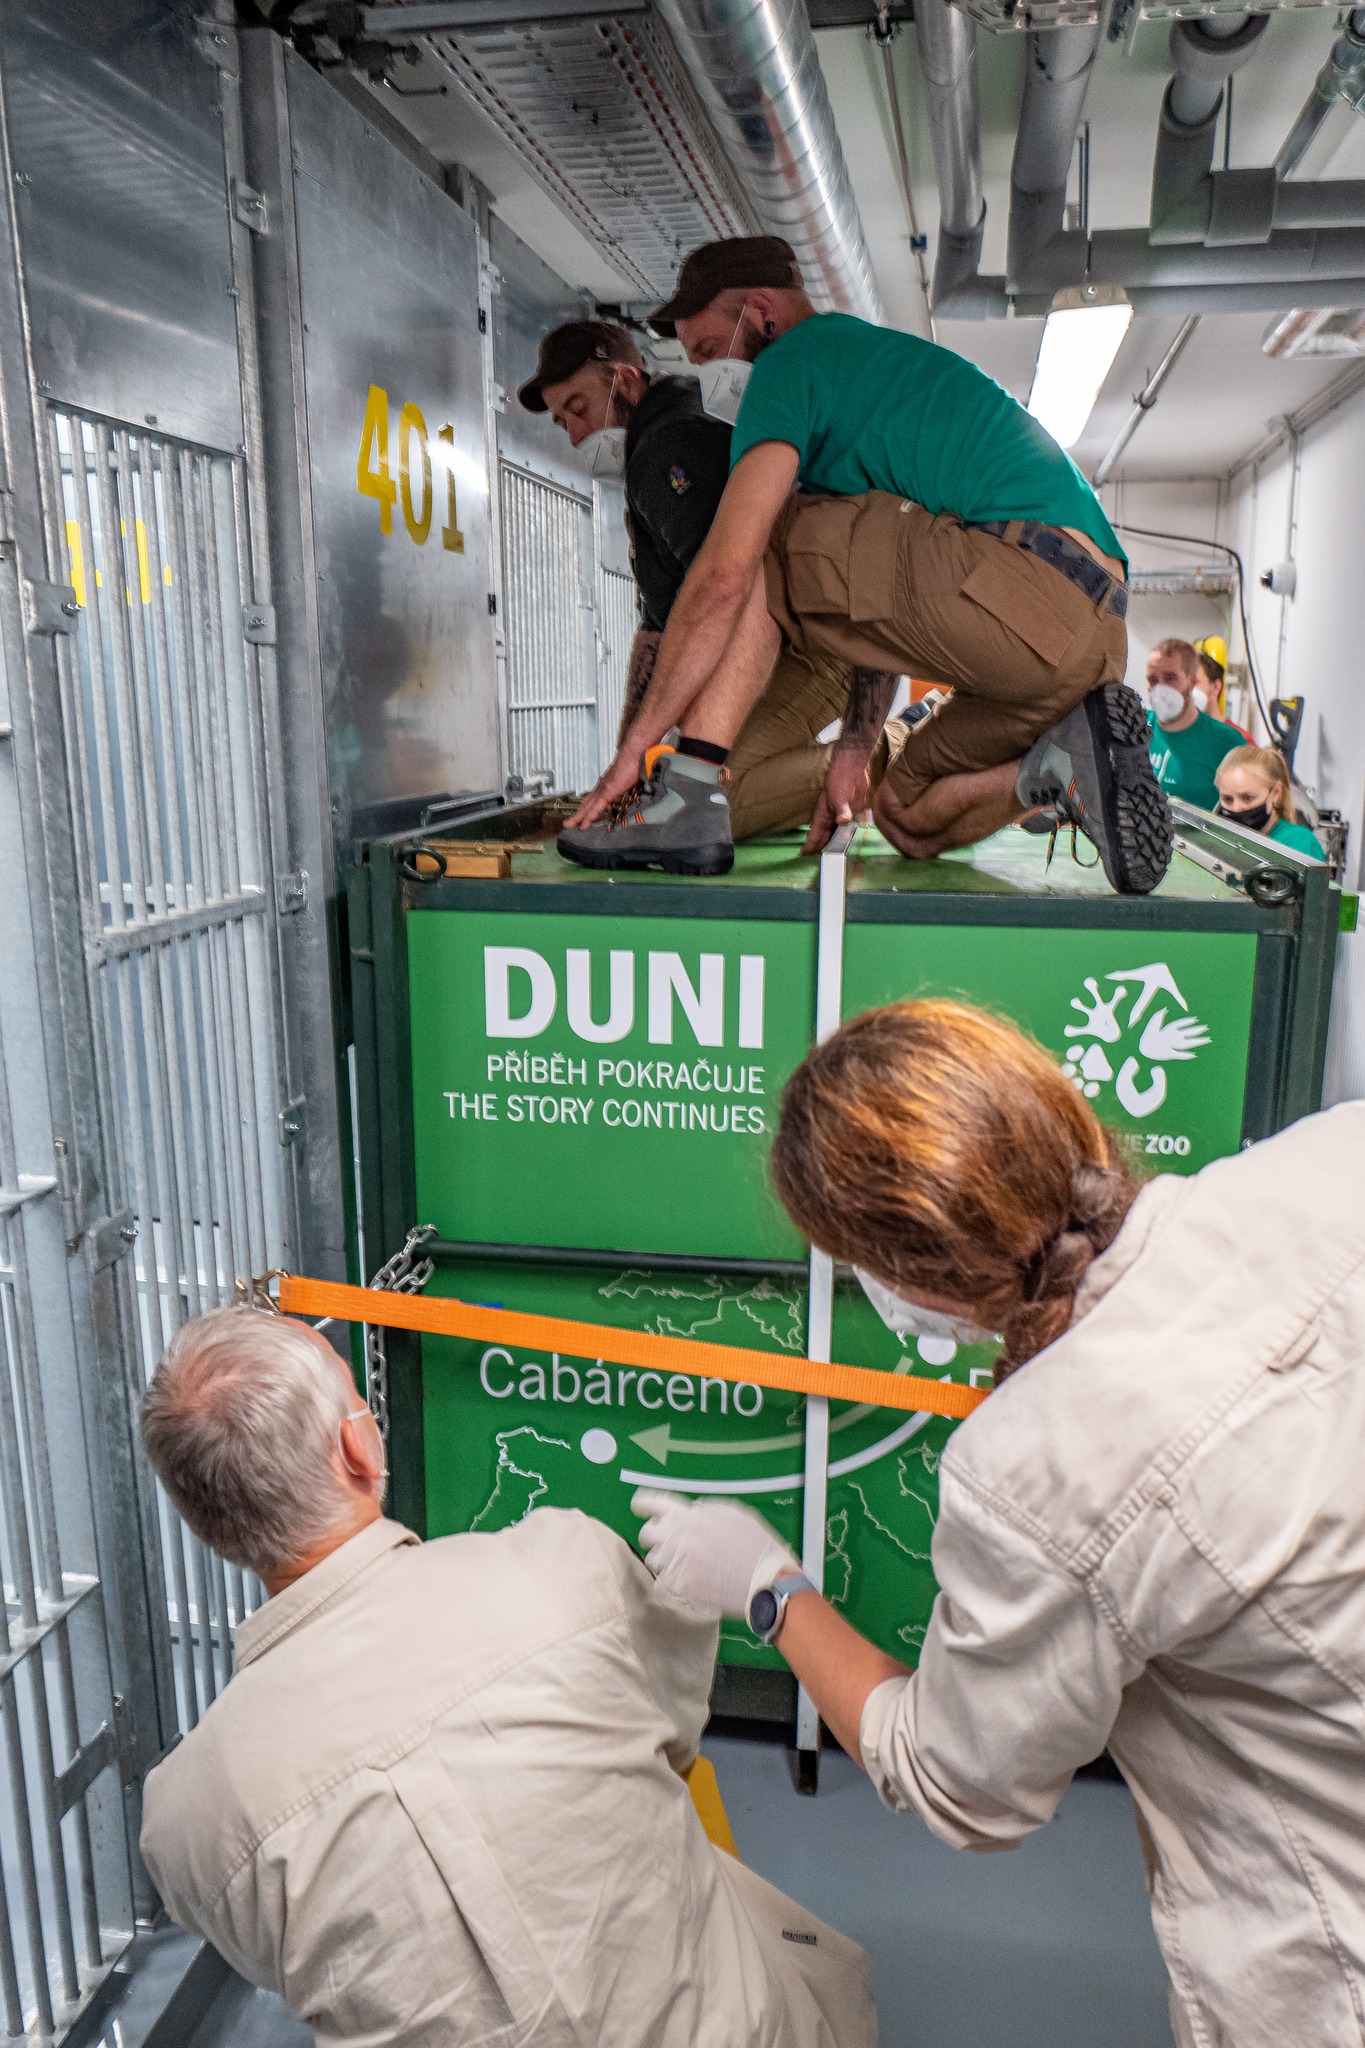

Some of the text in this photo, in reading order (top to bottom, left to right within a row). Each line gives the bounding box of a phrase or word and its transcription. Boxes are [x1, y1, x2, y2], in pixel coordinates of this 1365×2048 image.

[357, 383, 465, 555] 401
[484, 946, 765, 1049] DUNI
[487, 1050, 766, 1095] PŘÍBĚH POKRAČUJE
[443, 1091, 767, 1135] THE STORY CONTINUES
[1144, 1133, 1192, 1157] ZOO
[479, 1346, 764, 1417] Cabárceno
